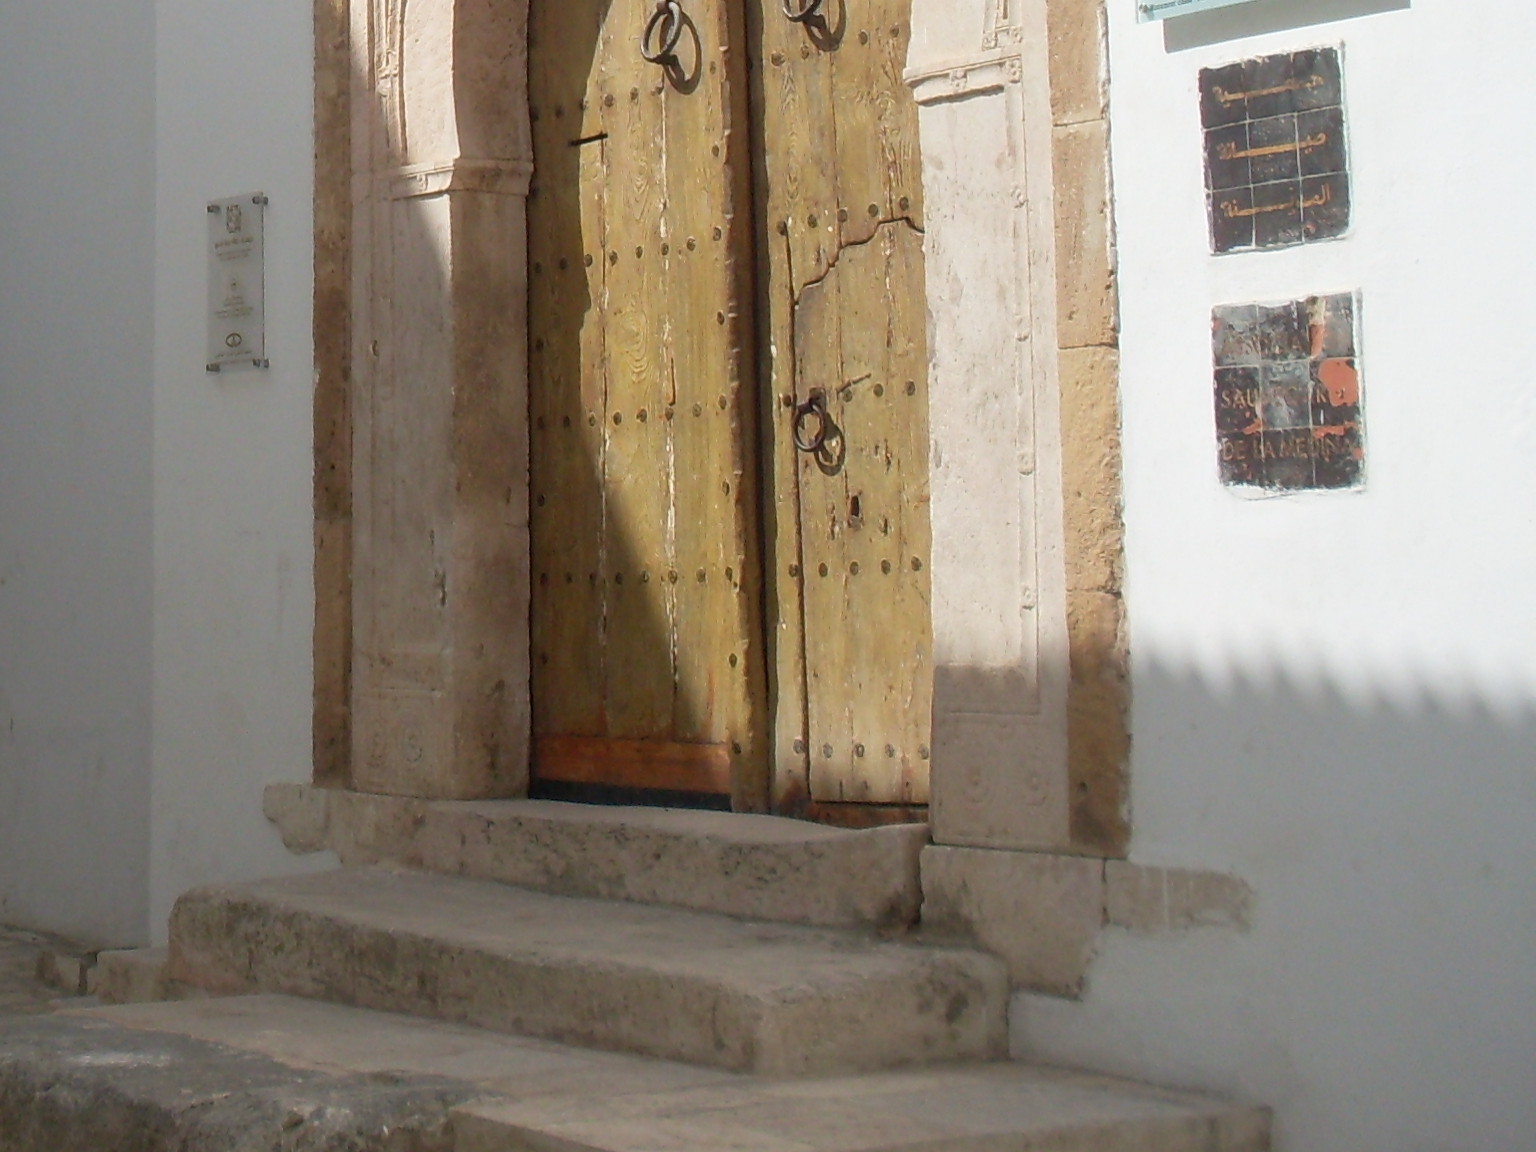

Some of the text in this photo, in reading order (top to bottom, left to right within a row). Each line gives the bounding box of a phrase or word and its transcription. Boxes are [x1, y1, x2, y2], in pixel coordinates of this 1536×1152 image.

[1216, 132, 1328, 161] صيانة
[1220, 183, 1333, 218] المدينة
[1222, 438, 1247, 461] DE
